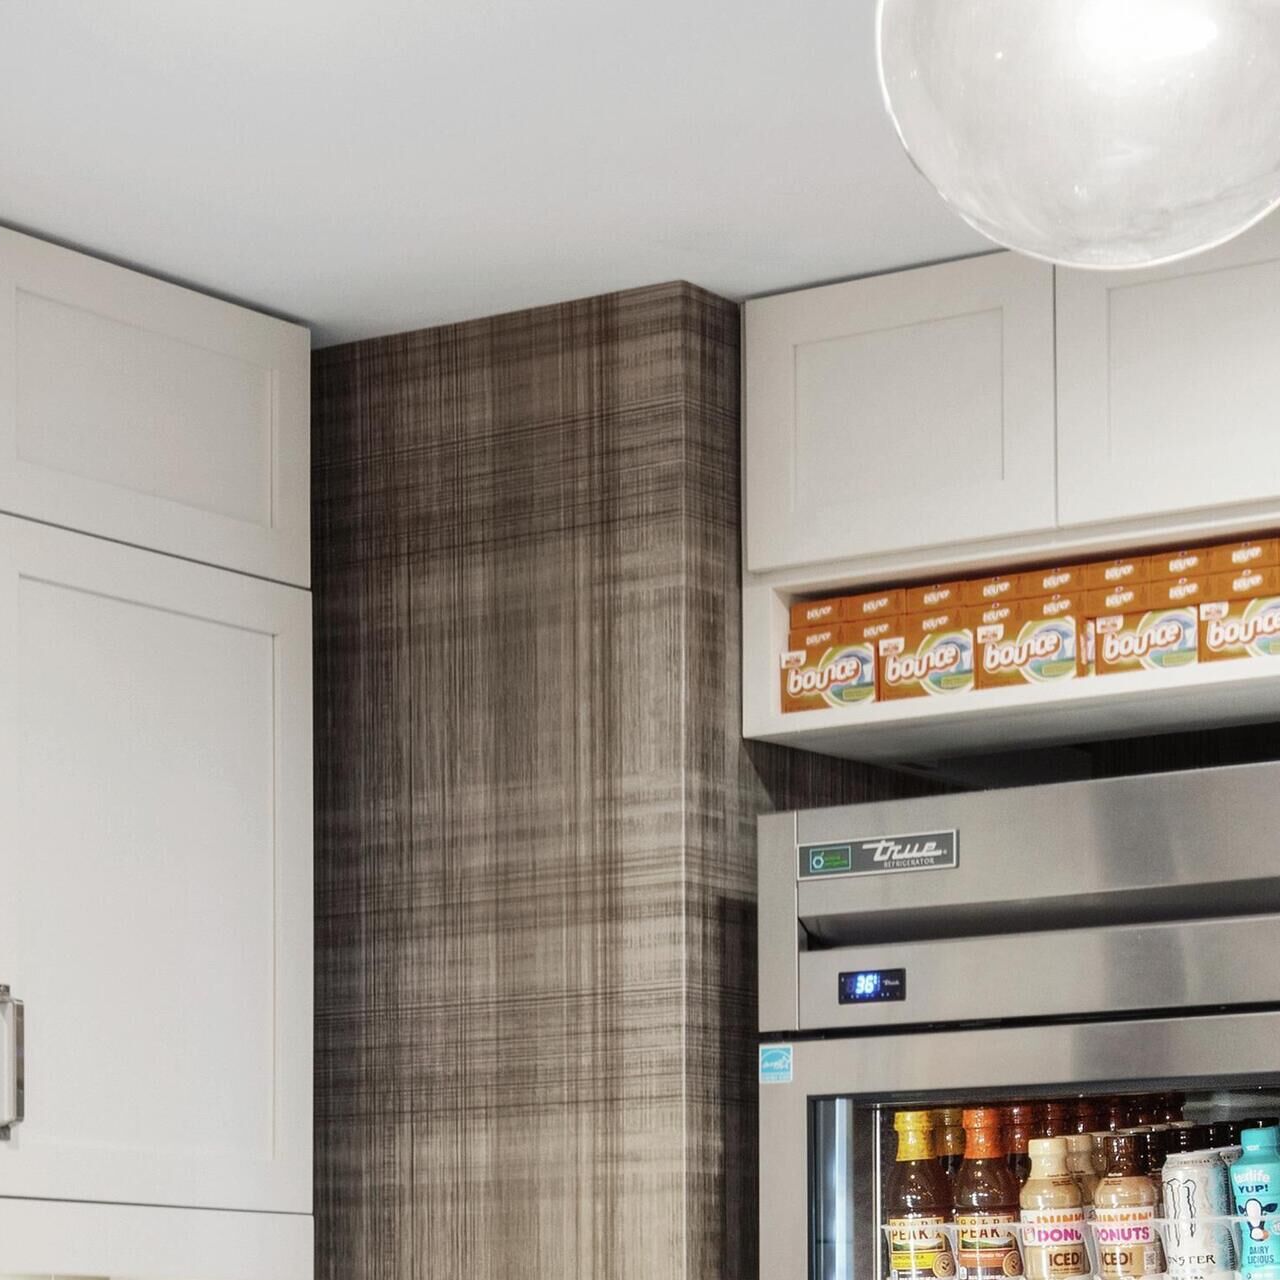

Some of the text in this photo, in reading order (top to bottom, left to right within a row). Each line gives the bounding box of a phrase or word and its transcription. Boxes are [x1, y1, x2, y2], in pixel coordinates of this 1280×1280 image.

[985, 632, 1061, 673] bounce
[1104, 622, 1183, 663] bounce
[787, 657, 861, 697] bounce
[887, 645, 960, 685] bounce
[883, 858, 935, 869] REFRIGERATOR
[1238, 1184, 1268, 1194] YUP!
[1249, 1246, 1269, 1255] DAIRY
